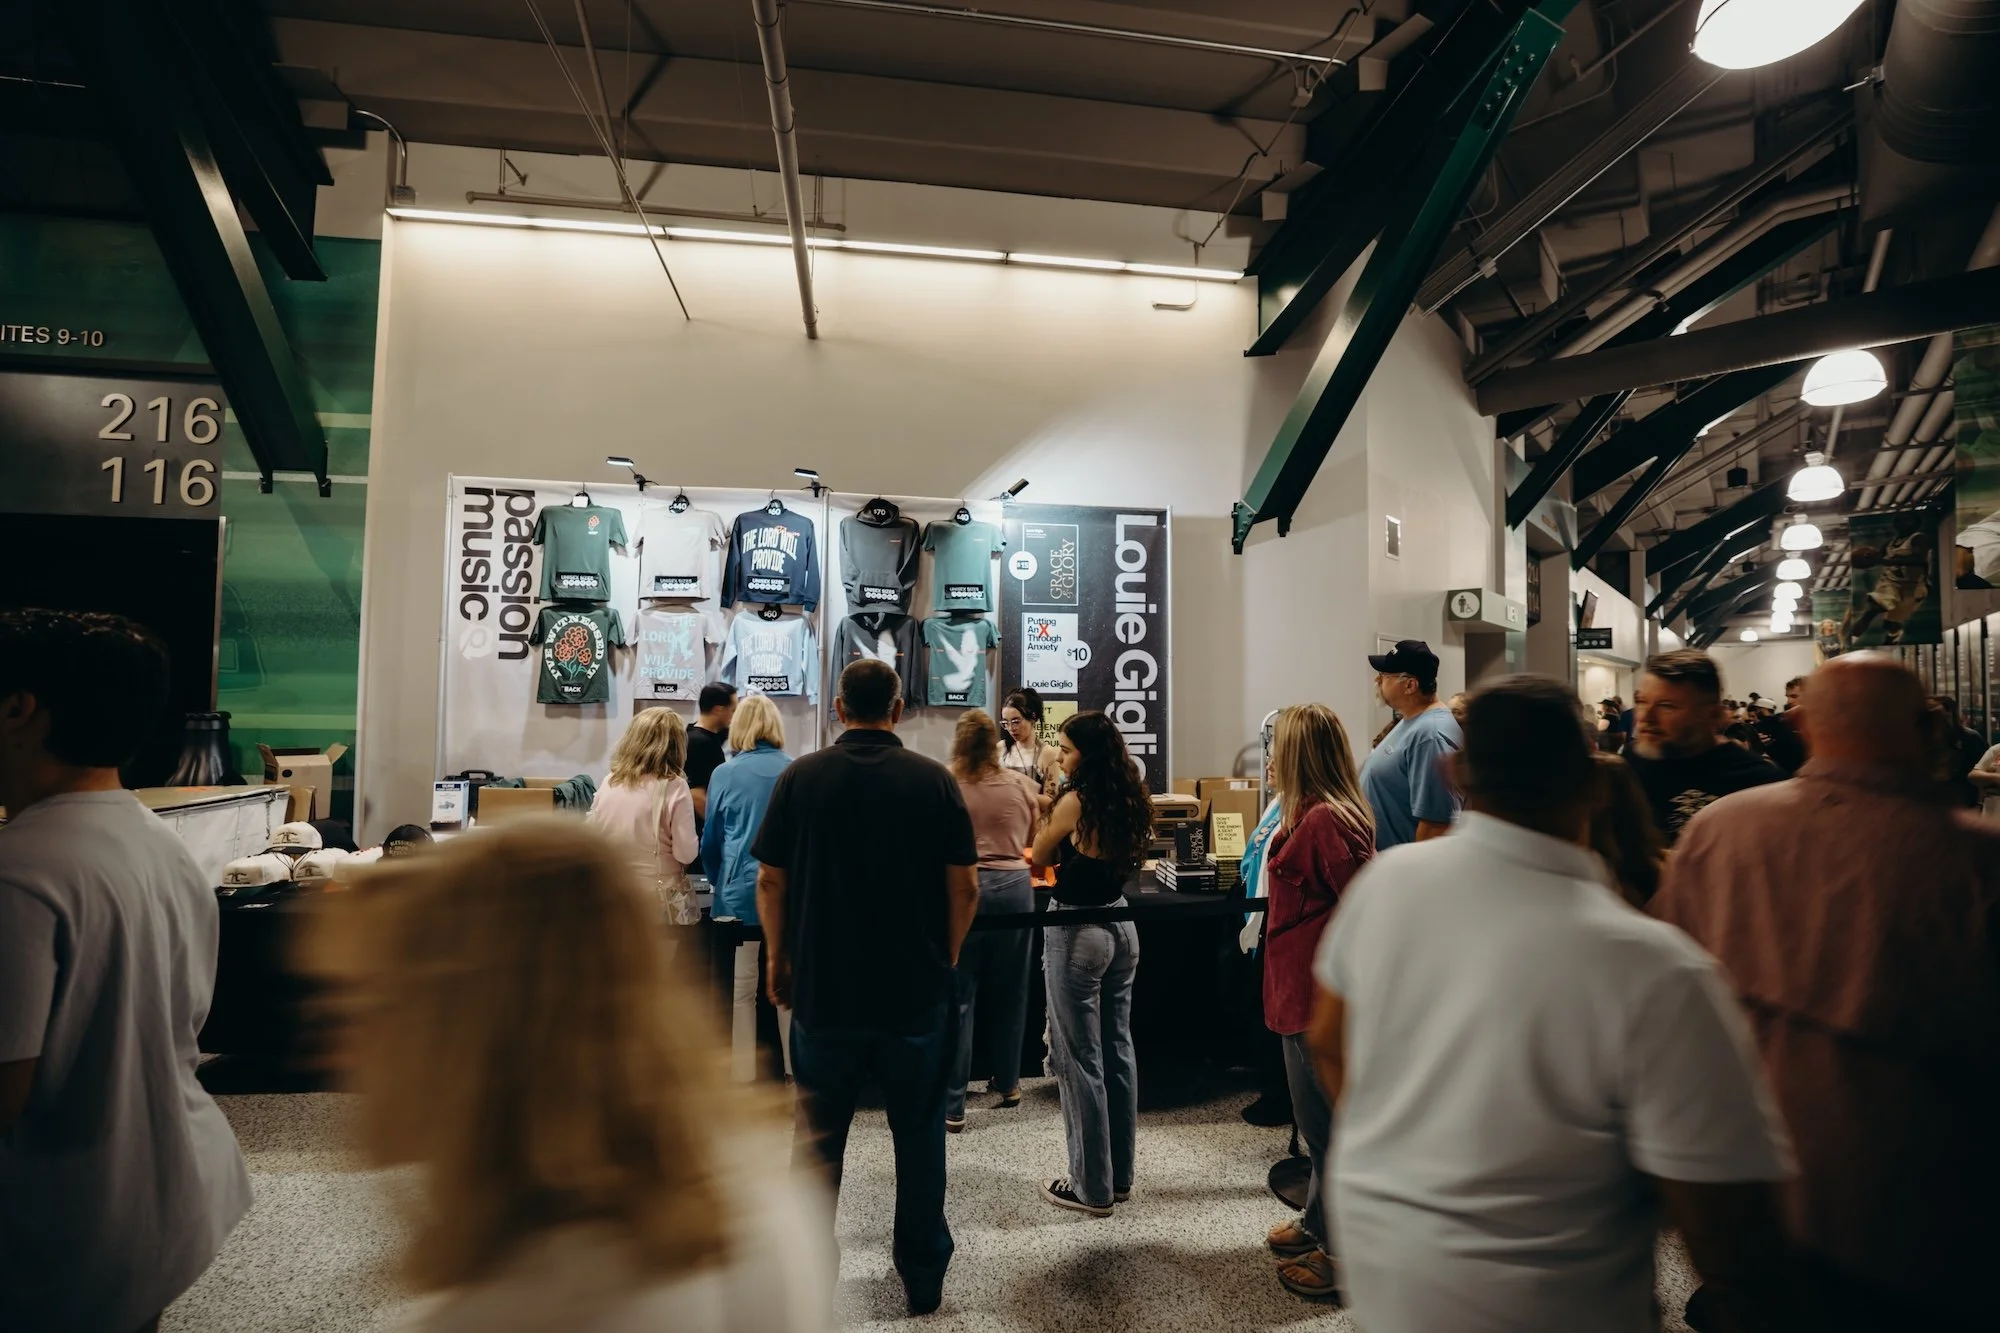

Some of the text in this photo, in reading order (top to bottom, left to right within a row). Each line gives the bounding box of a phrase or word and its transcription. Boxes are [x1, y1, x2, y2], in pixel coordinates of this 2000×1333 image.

[57, 328, 104, 347] 9-10
[98, 392, 221, 445] 216
[101, 456, 217, 507] 116
[768, 508, 781, 516] $60
[873, 508, 886, 516] $70
[743, 527, 798, 561] THE LORD WILL
[459, 486, 500, 621] music
[751, 549, 786, 574] PROVIDE
[1062, 538, 1075, 599] & GLORY
[496, 488, 541, 660] passion
[1050, 549, 1063, 600] GRACE
[1114, 514, 1158, 645] Louie
[672, 615, 697, 627] THE
[764, 610, 778, 618] $60
[1027, 617, 1057, 626] Putting
[642, 630, 675, 643] LORD
[1027, 625, 1039, 634] An
[1028, 633, 1062, 643] Through
[545, 614, 605, 660] WITNESSED
[586, 661, 601, 680] IT
[1027, 642, 1058, 652] Anxiety
[1066, 647, 1088, 661] $10
[640, 666, 695, 680] PROVIDE
[563, 685, 581, 693] BACK
[1027, 680, 1073, 689] Louie Giglio
